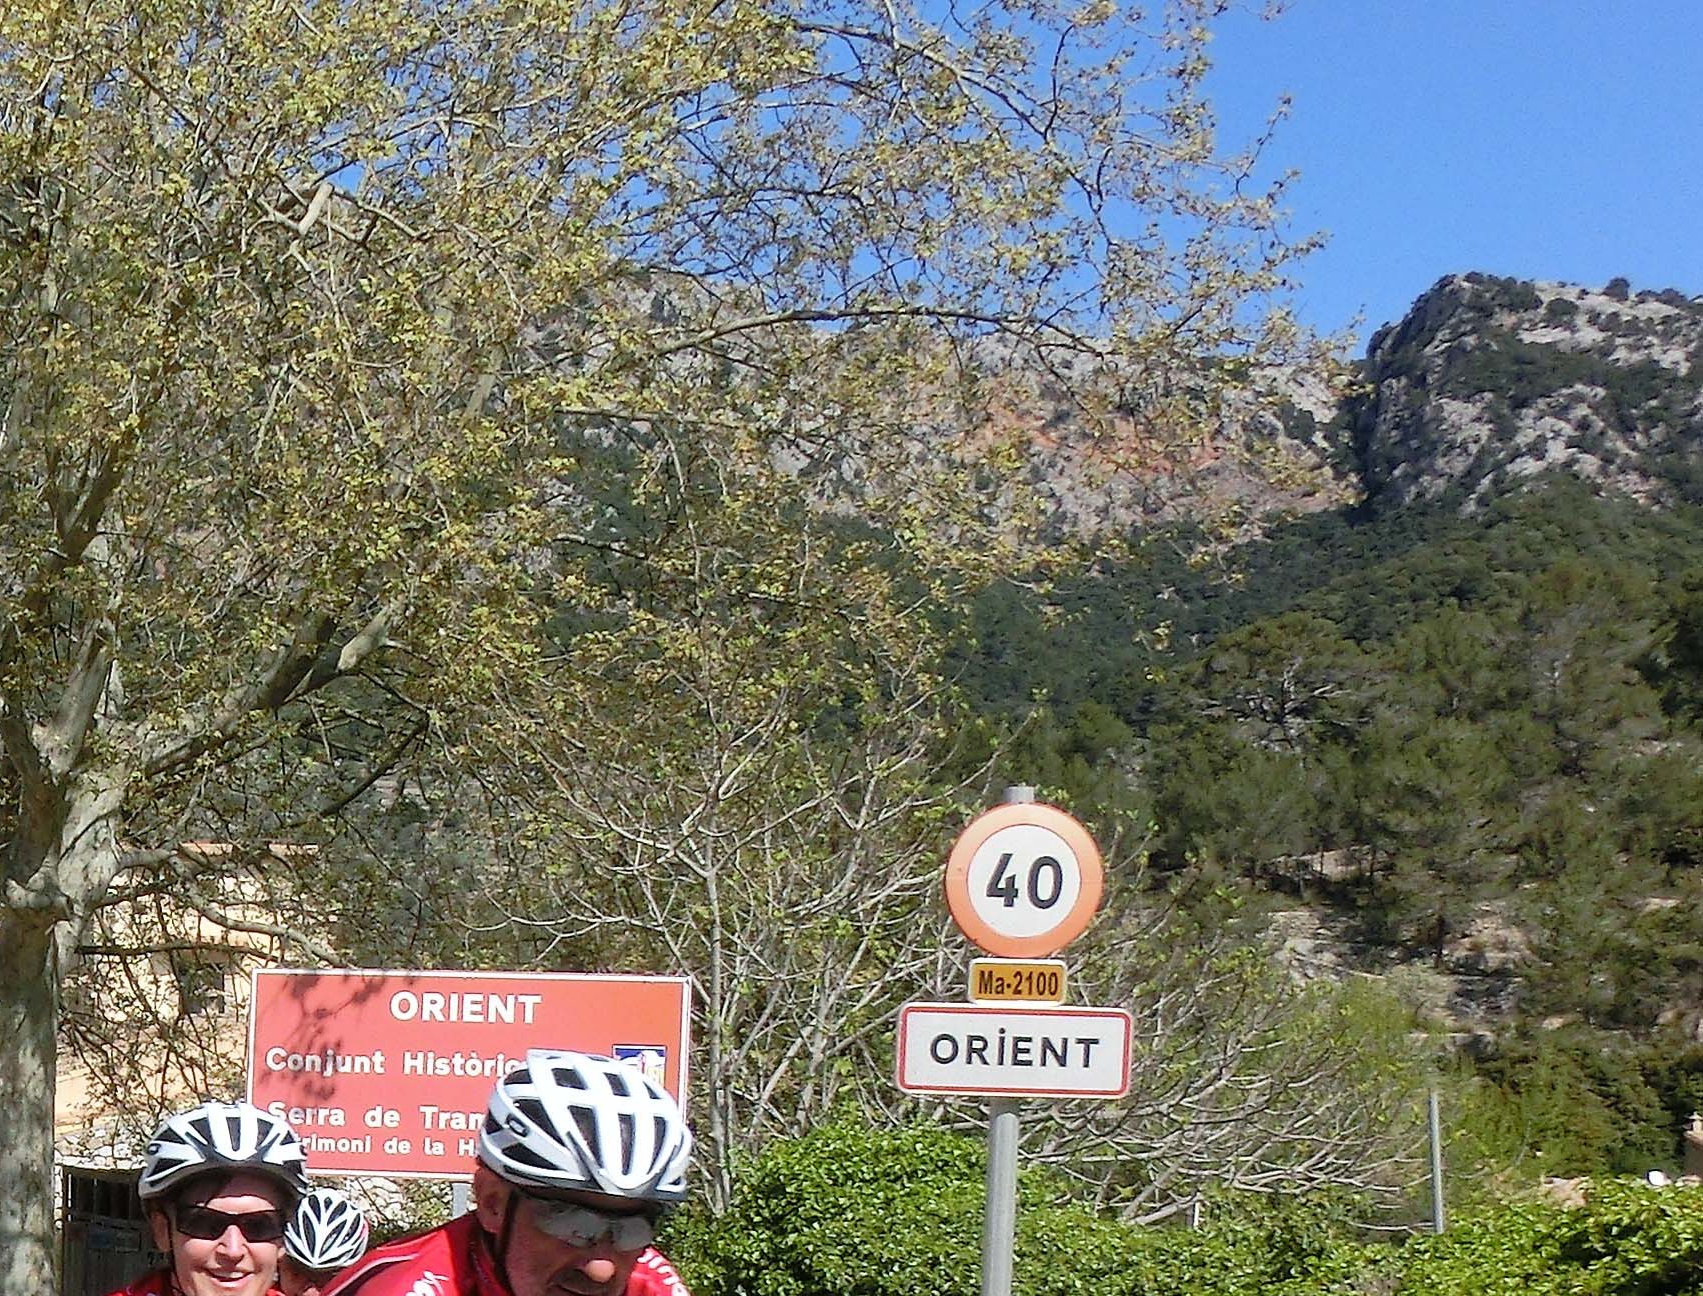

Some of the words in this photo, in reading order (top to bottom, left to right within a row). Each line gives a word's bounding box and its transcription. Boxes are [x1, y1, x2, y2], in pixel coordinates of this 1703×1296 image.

[986, 853, 1063, 910] 40
[390, 990, 542, 1025] ORIENT
[265, 1047, 386, 1077] Conjunt
[267, 1101, 345, 1127] Serra
[364, 1105, 400, 1128] de
[297, 1134, 372, 1154] rimoni
[383, 1136, 411, 1155] de
[424, 1137, 444, 1156] la
